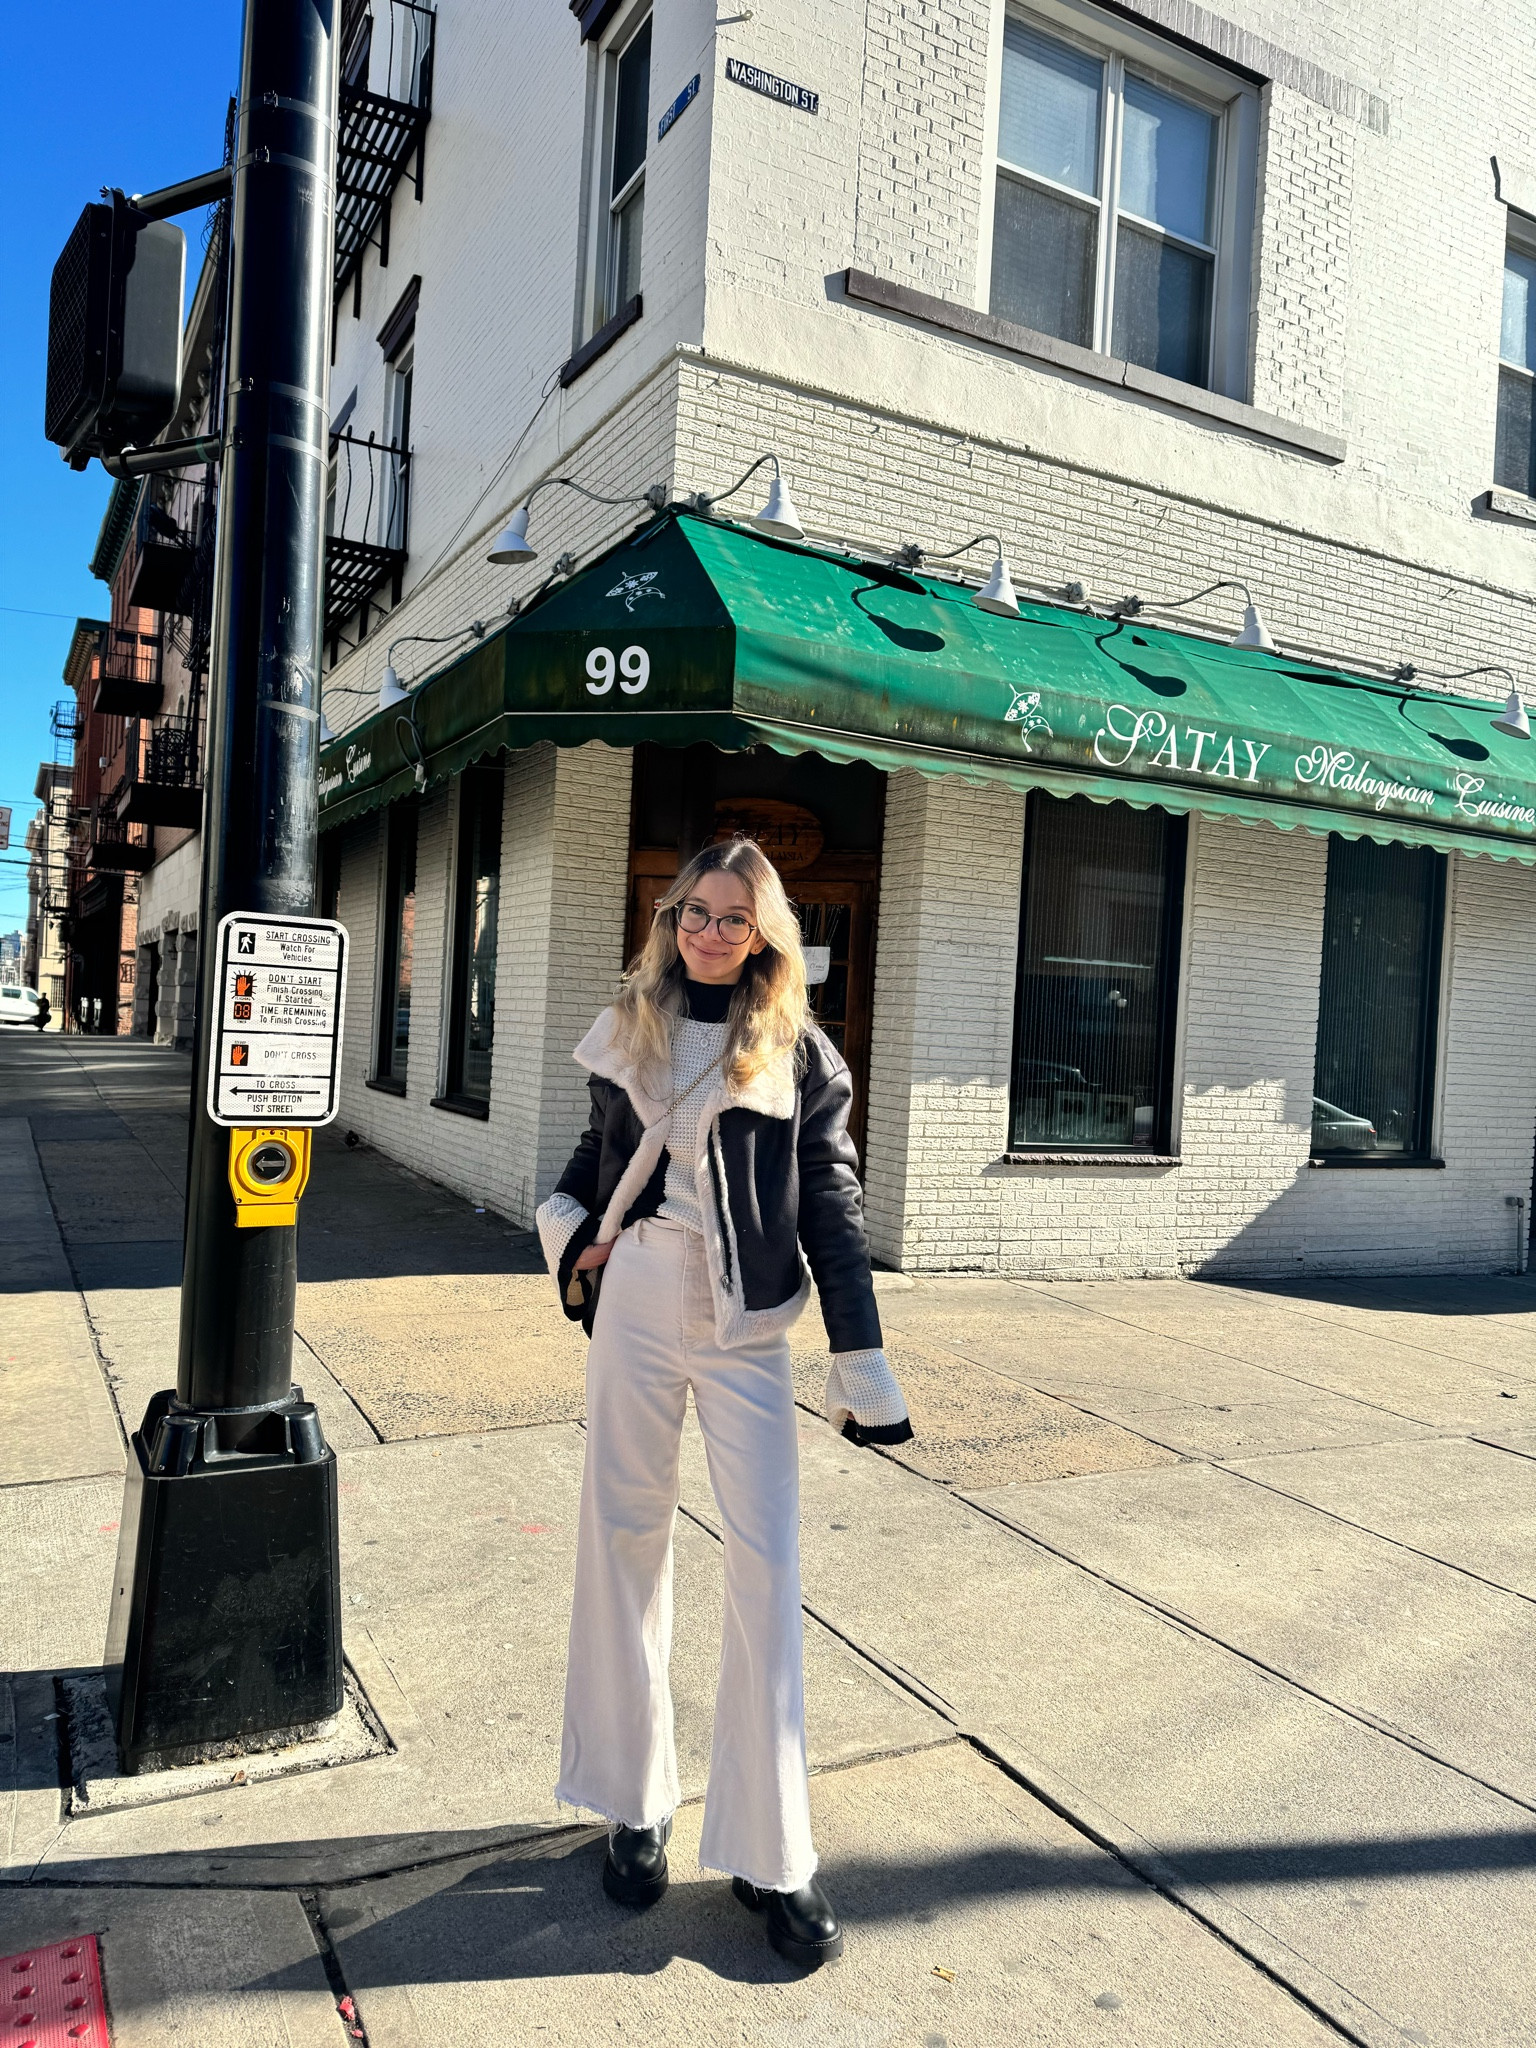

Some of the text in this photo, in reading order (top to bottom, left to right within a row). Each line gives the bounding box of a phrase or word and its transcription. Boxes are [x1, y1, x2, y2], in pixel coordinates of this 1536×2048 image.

[730, 60, 799, 104] WASHINGTON
[660, 102, 677, 136] FIRST
[585, 645, 651, 696] 99
[1094, 704, 1272, 783] SATAY
[1295, 745, 1536, 825] Malaysian Cuisine
[266, 931, 331, 944] START CROSSING
[280, 943, 316, 954] Watch For
[283, 952, 312, 963] Vehicles
[269, 974, 322, 985] DON'T START
[267, 985, 323, 997] Finish Crossing
[276, 995, 313, 1004] If Started
[234, 1003, 250, 1017] 08
[261, 1006, 327, 1017] TIME REMAINING
[260, 1015, 268, 1023] To
[270, 1015, 292, 1025] Finish
[264, 1050, 317, 1060] DON'T CROSS
[256, 1080, 296, 1089] TO CROSS
[247, 1094, 303, 1103] PUSH BUTTON
[252, 1104, 293, 1113] 1ST STREET
